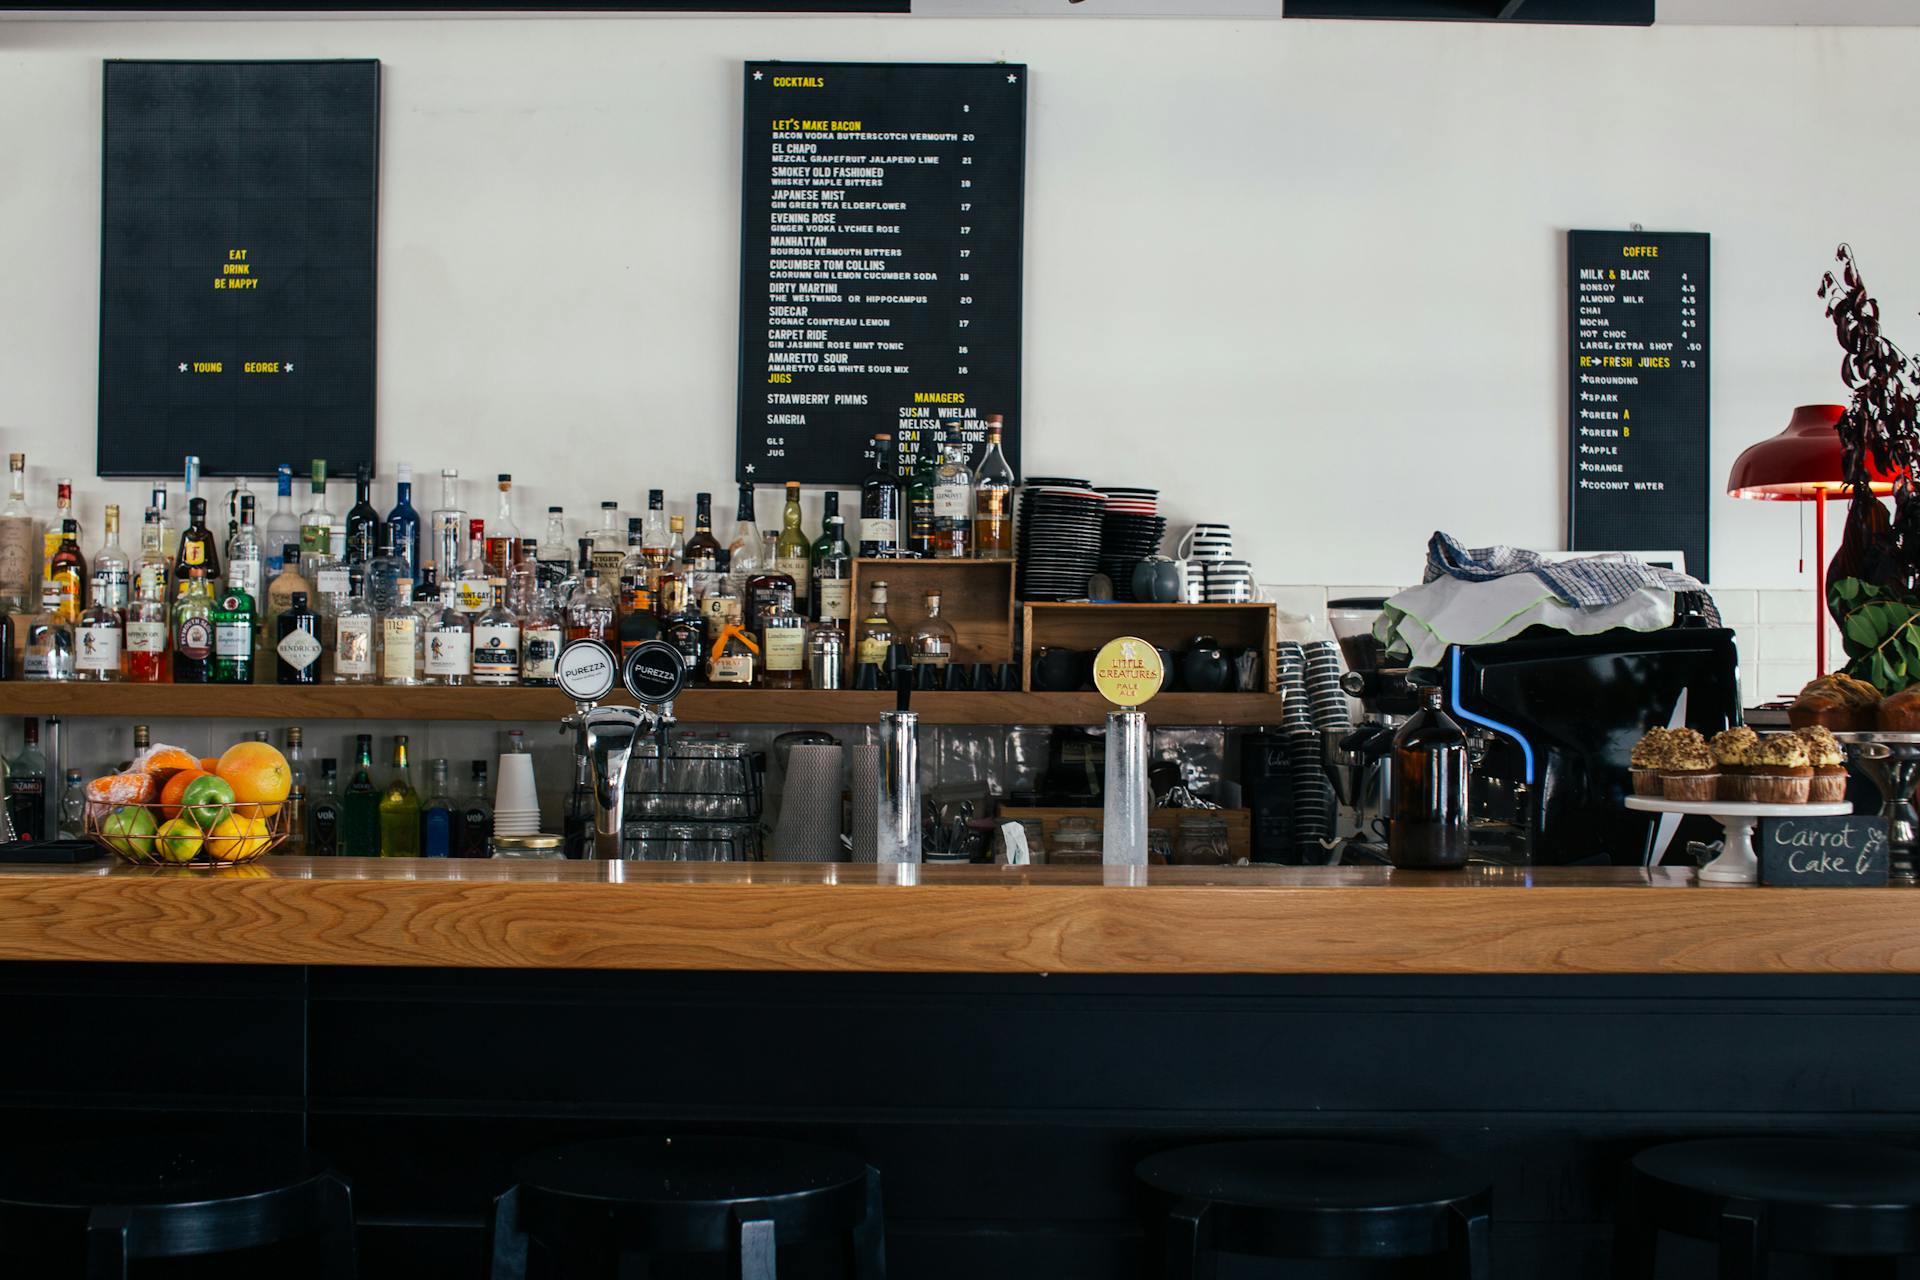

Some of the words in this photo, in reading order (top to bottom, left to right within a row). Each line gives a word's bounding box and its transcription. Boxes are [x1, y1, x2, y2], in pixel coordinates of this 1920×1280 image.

[774, 77, 823, 87] COCKTAILS
[773, 119, 799, 130] LET'S
[802, 121, 828, 130] MAKE
[831, 121, 861, 131] BACON
[773, 144, 784, 153] EL
[787, 144, 817, 153] CHAPO
[772, 167, 810, 177] SMOKEY
[813, 167, 831, 177] OLD
[833, 168, 883, 177] FASHIONED
[772, 190, 818, 200] JAPANESE
[821, 191, 845, 200] MIST
[771, 213, 809, 223] EVENING
[812, 214, 835, 223] ROSE
[771, 237, 827, 246] MANHATTAN
[230, 250, 246, 259] EAT
[1623, 247, 1657, 256] COFFEE
[224, 264, 249, 274] DRINK
[770, 260, 820, 270] CUCUMBER
[823, 260, 843, 270] TOM
[846, 261, 885, 270] COLLINS
[1581, 269, 1603, 279] MILK
[1609, 270, 1615, 279] &
[1621, 270, 1649, 280] BLACK
[215, 279, 226, 288] BE
[229, 279, 257, 288] HAPPY
[770, 283, 796, 293] DIRTY
[799, 283, 837, 293] MARTINI
[770, 294, 787, 302] THE
[769, 306, 808, 316] SIDECAR
[769, 330, 804, 339] CARPET
[807, 330, 827, 340] RIDE
[768, 353, 818, 363] AMARETTO
[824, 354, 848, 363] SOUR
[1638, 357, 1670, 367] JUICES
[1681, 360, 1695, 368] 7.5
[194, 363, 222, 372] YOUNG
[245, 363, 278, 372] GEORGE
[768, 374, 791, 383] JUGS
[768, 394, 829, 404] STRAWBERRY
[835, 395, 867, 404] PIMMS
[915, 393, 964, 403] MANAGERS
[900, 408, 929, 417] SUSAN
[938, 408, 976, 418] WHELAN
[1624, 409, 1629, 419] A
[767, 415, 805, 424] SANGRIA
[900, 419, 940, 429] MELISSA
[899, 431, 920, 440] CRAI
[1624, 427, 1629, 437] B
[1634, 482, 1663, 490] WATER
[1112, 659, 1143, 668] LITTLE
[565, 662, 606, 677] PUREZZA
[635, 664, 674, 681] PUREZZA
[1099, 670, 1157, 679] CREATURES
[1775, 821, 1857, 849] Carrot
[1788, 850, 1850, 873] Cake
